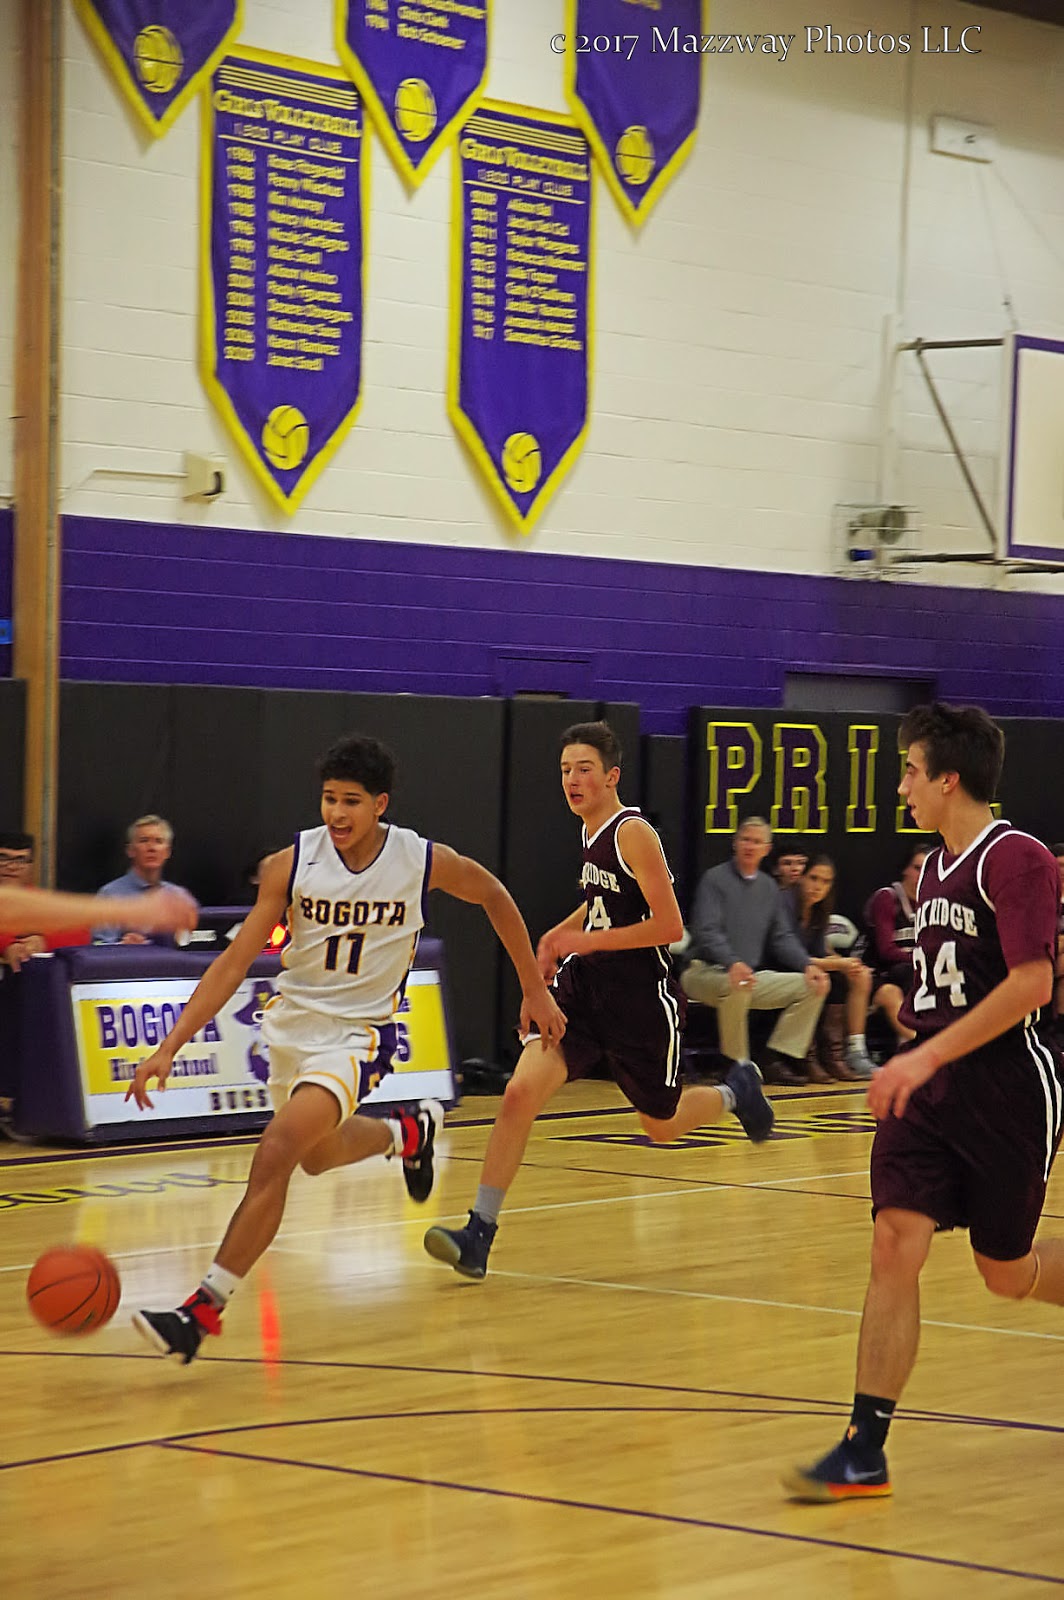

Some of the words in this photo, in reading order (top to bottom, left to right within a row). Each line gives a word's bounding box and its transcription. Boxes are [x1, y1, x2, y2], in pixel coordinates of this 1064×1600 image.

[705, 721, 1003, 833] PRI
[299, 895, 406, 927] BOGOTA
[325, 932, 366, 975] 11
[913, 942, 967, 1013] 24
[96, 1002, 222, 1048] BOGOA
